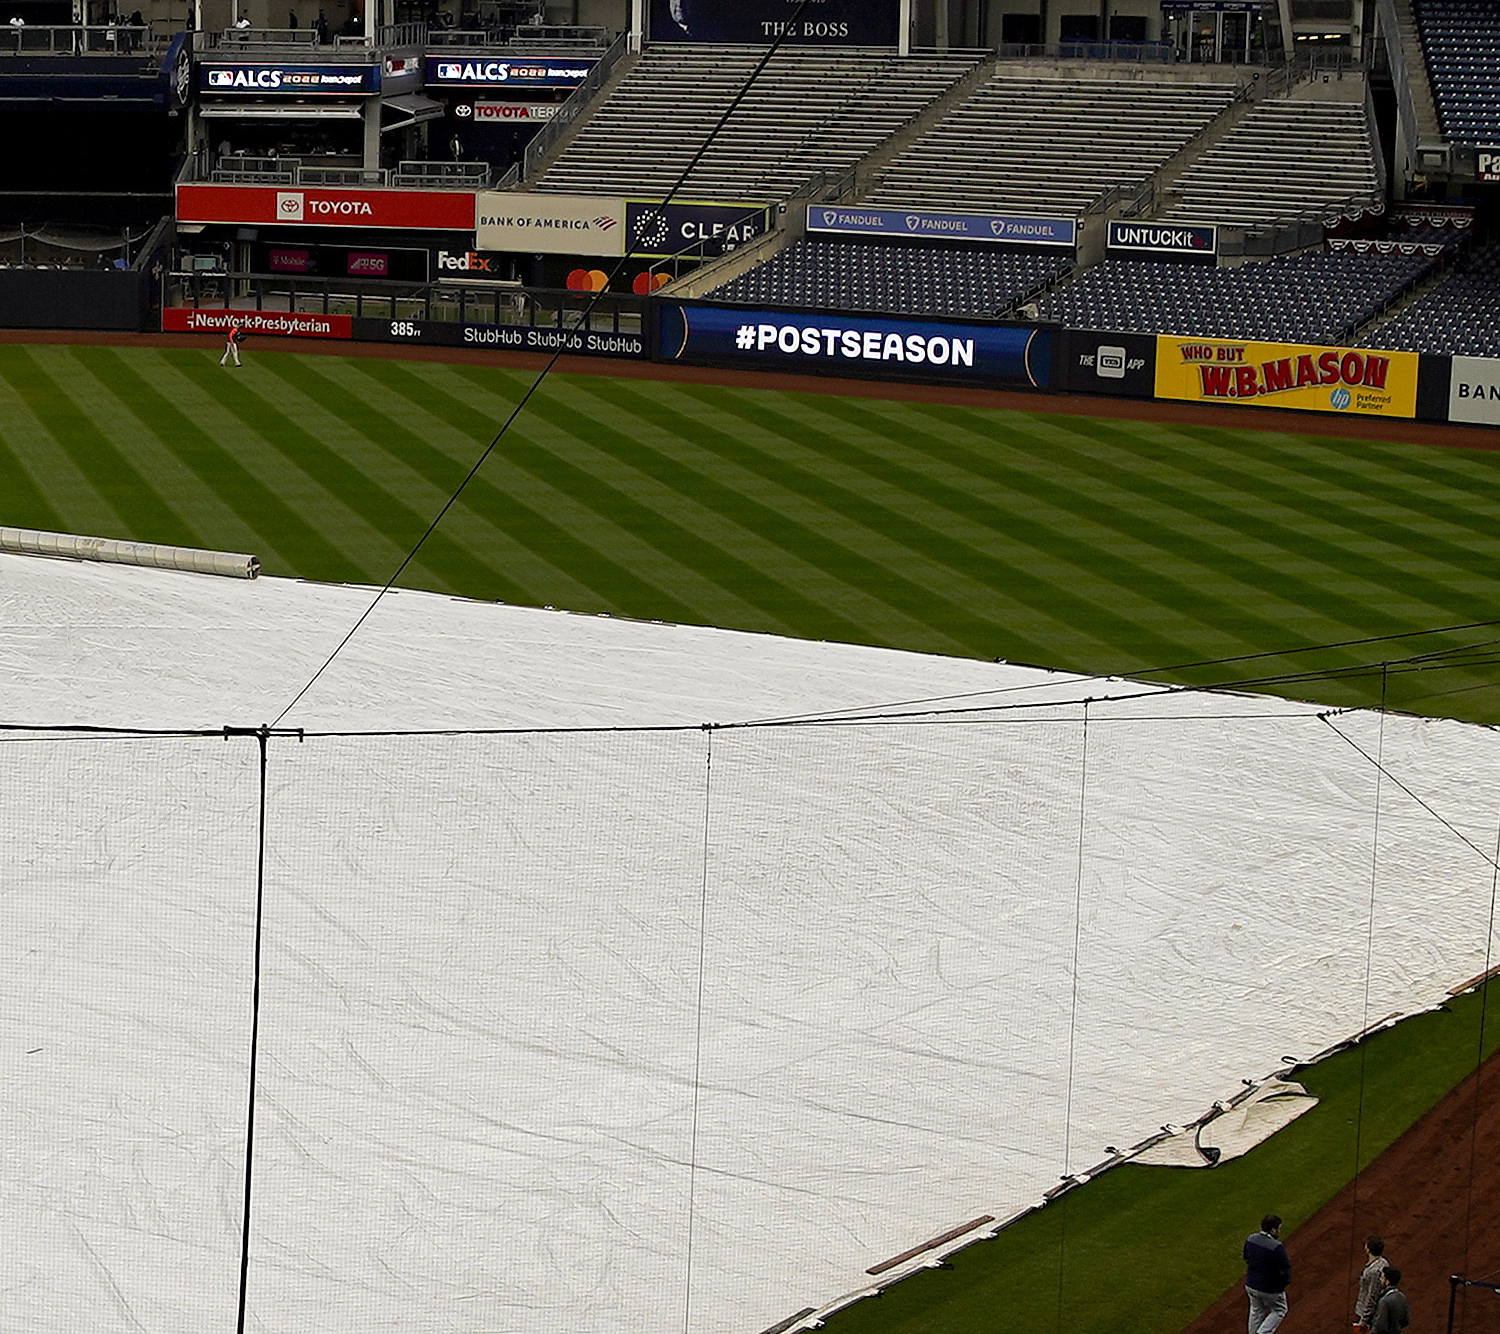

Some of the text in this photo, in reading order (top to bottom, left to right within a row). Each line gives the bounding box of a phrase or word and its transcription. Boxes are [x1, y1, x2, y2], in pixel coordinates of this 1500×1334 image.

[761, 21, 849, 37] THE BOSS
[233, 70, 282, 87] ALCS
[461, 63, 510, 81] ALCS
[476, 107, 529, 117] TOYOTA
[309, 201, 373, 215] TOYOTA
[481, 217, 590, 229] BANK OF AMERICA
[838, 214, 1054, 236] FANDUEL FANDUEL FANDUEL
[681, 222, 755, 242] CLEAR
[1117, 228, 1194, 247] UNTUCKit
[438, 251, 492, 272] FedEx
[390, 321, 413, 337] 385
[464, 328, 643, 353] StubHub StubHub StubHub
[736, 325, 974, 367] #POSTSEASON
[1181, 347, 1245, 361] WHO BUT
[1126, 358, 1146, 370] APP
